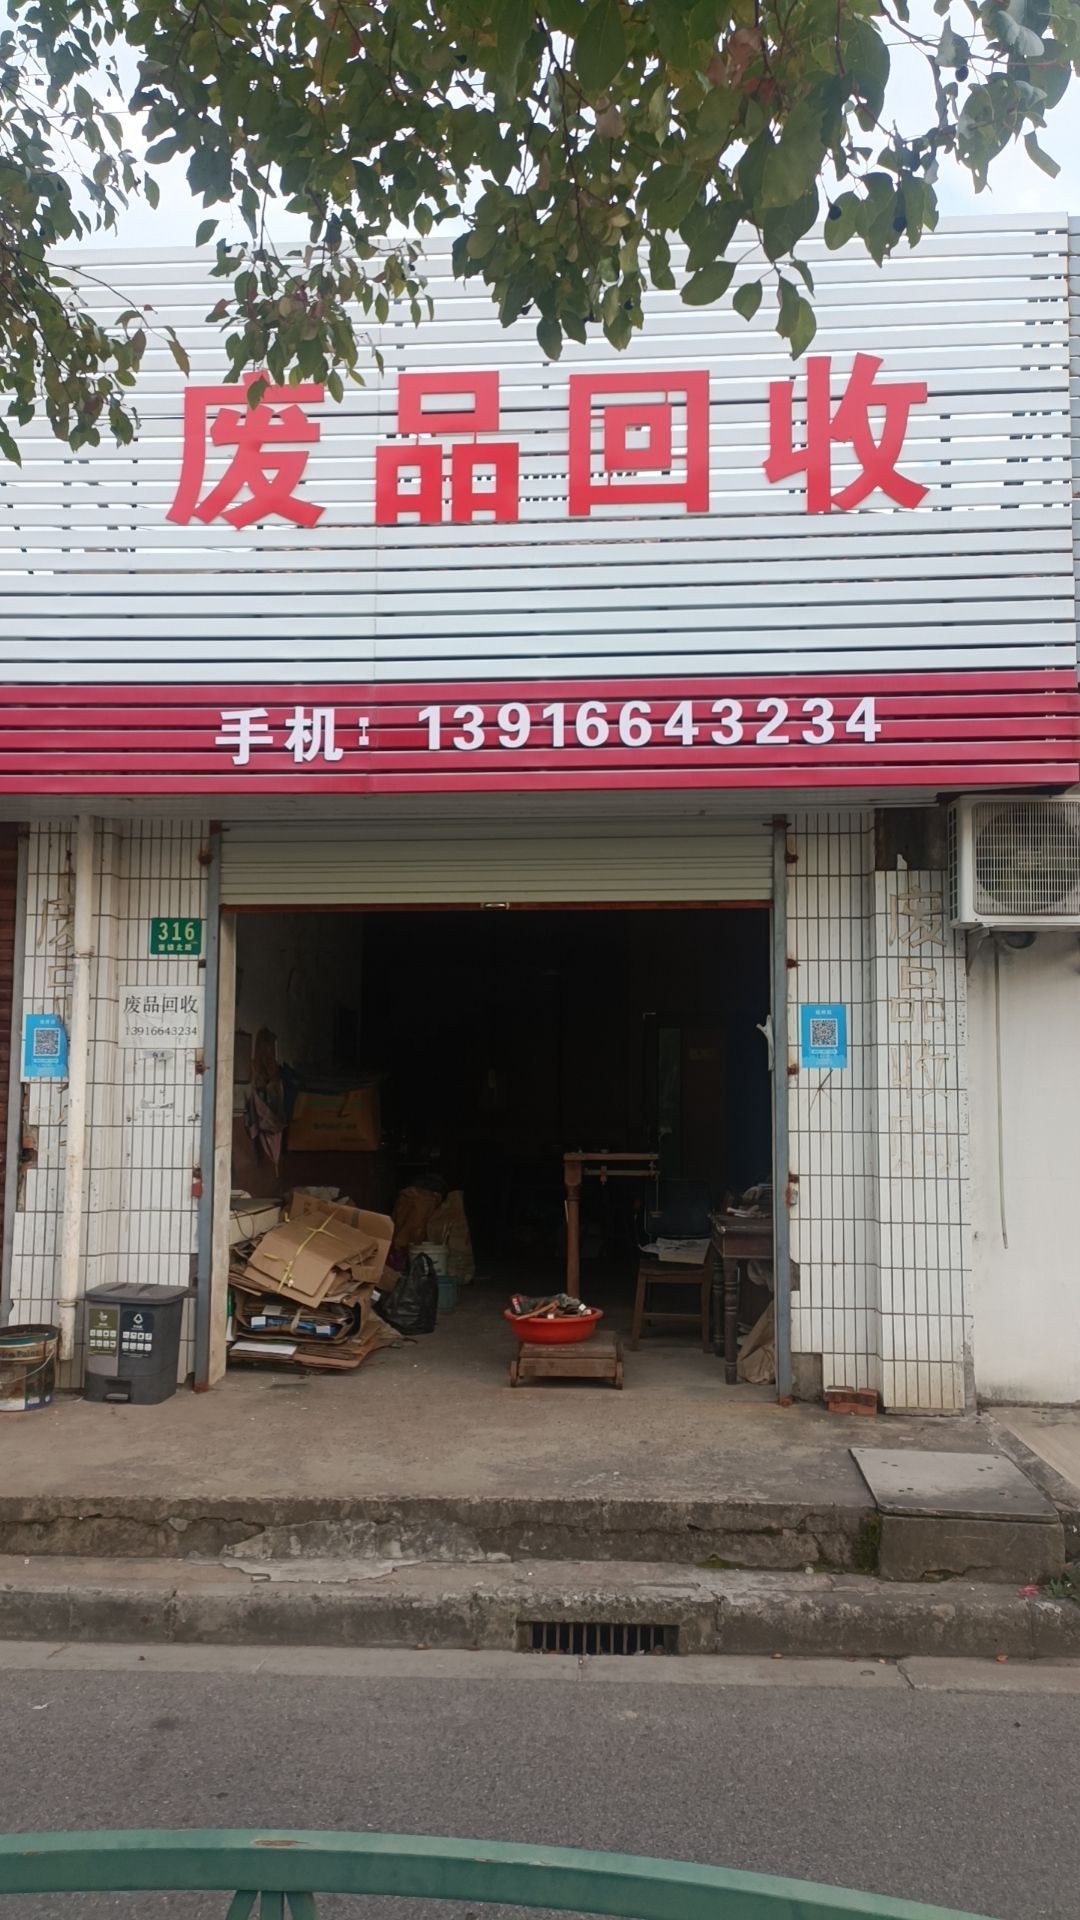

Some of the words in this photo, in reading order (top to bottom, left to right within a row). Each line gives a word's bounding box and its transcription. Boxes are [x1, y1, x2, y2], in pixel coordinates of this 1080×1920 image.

[166, 352, 930, 530] 废品回收
[418, 696, 882, 750] 13916643234
[158, 922, 195, 941] 316
[123, 994, 199, 1014] 废品回收
[125, 1026, 198, 1036] 13916643234
